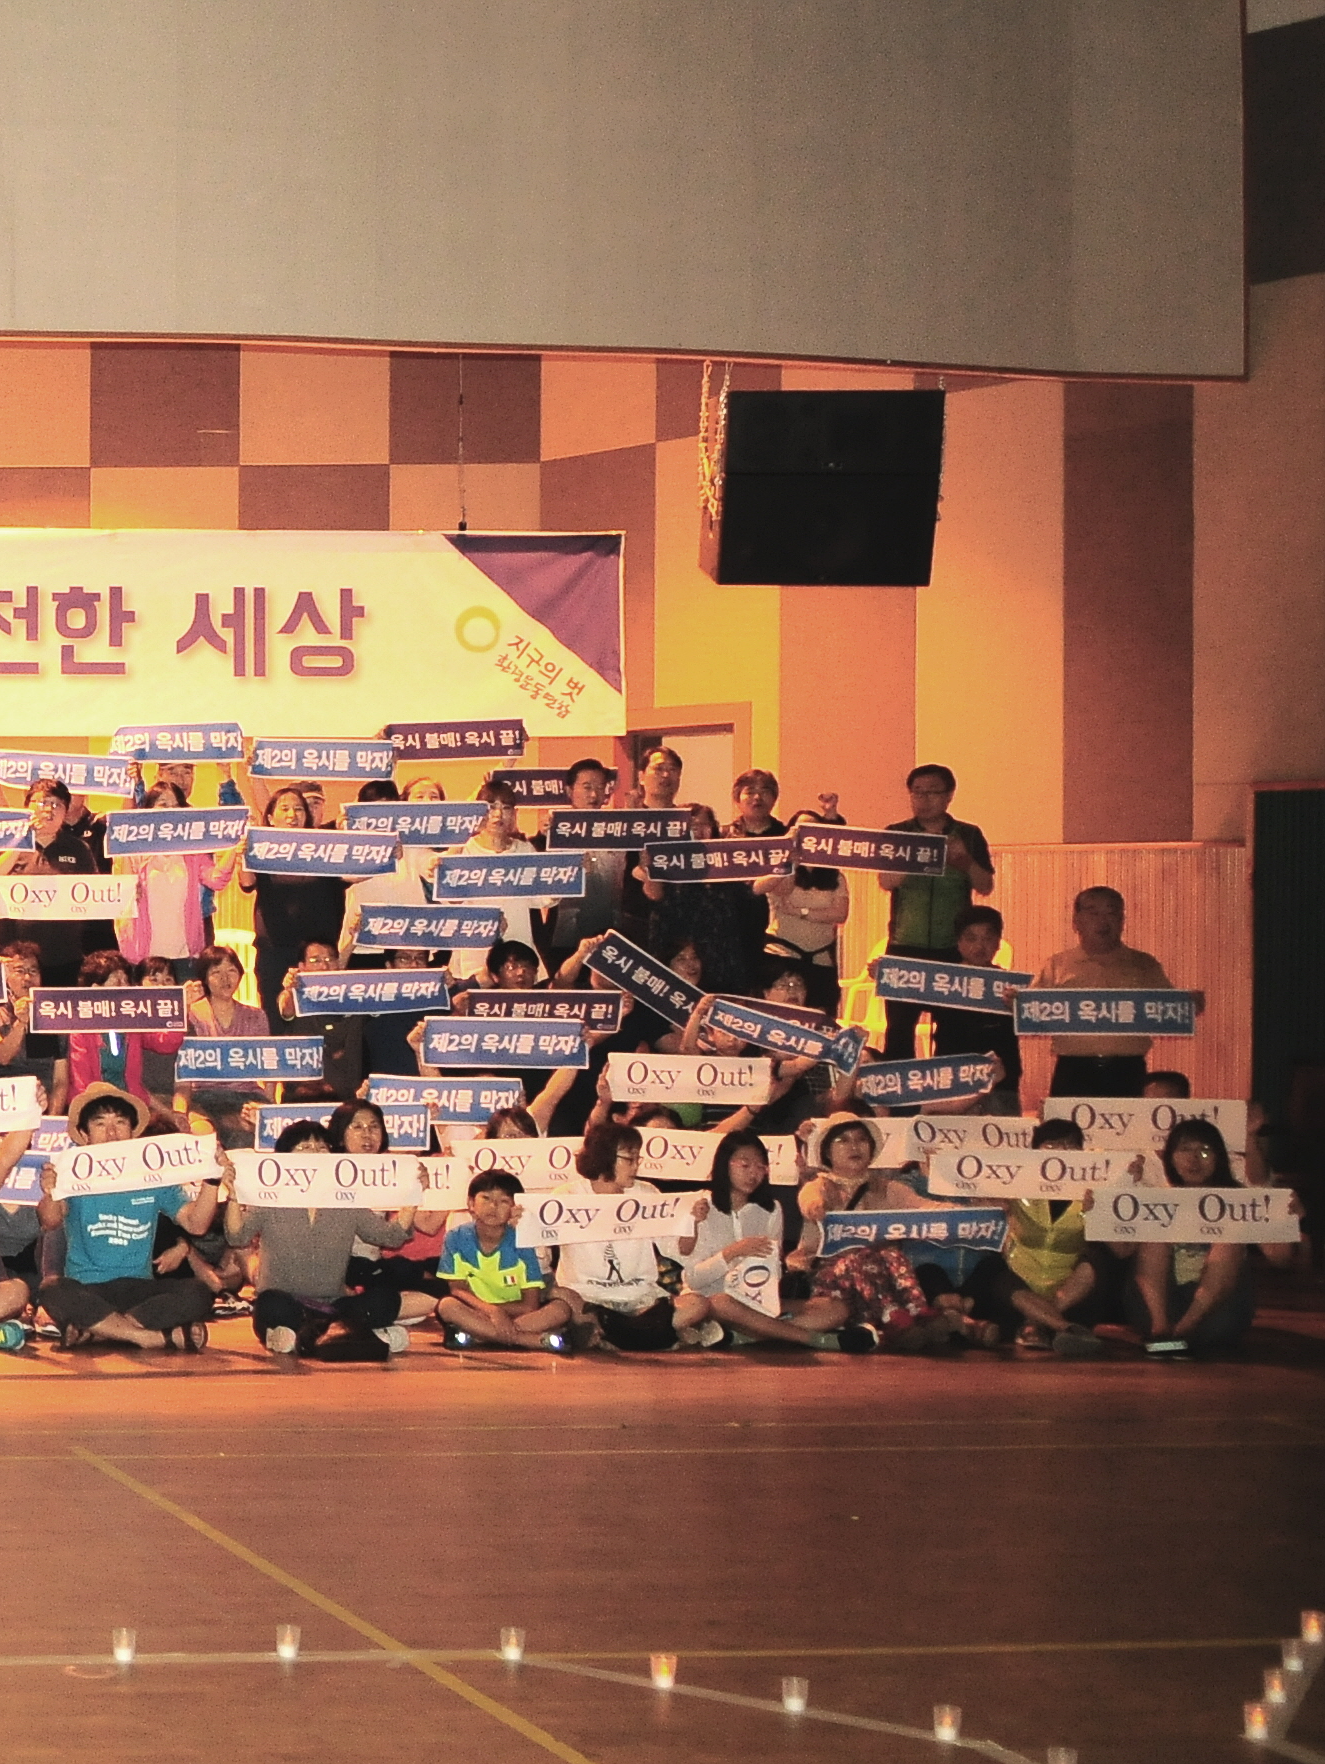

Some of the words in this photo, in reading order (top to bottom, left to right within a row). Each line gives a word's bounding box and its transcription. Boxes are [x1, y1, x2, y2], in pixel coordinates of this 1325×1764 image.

[177, 586, 365, 678] 세상
[507, 635, 563, 685] 지구의
[561, 677, 585, 703] 벗
[391, 732, 420, 749] 옥시
[425, 731, 461, 748] 불매!
[465, 729, 495, 746] 옥시
[499, 727, 520, 745] 끝!
[250, 843, 294, 861] 제2의
[298, 844, 347, 862] 옥시를
[352, 845, 391, 863] 막자!
[801, 836, 833, 855] 옥시
[838, 838, 875, 857] 불매!
[879, 843, 911, 860] 옥시
[916, 846, 938, 862] 끝!
[443, 867, 485, 887] 제2의
[488, 867, 536, 886] 옥시를
[539, 866, 576, 884] 막자!
[302, 987, 346, 1002] 제2의
[348, 984, 396, 1001] 옥시를
[403, 983, 439, 998] 막자!
[39, 1002, 72, 1019] 옥시
[78, 1001, 116, 1019] 불매!
[120, 1000, 152, 1016] 옥시
[156, 999, 179, 1016] 끝!
[1022, 1001, 1070, 1021] 제2의
[1077, 1000, 1136, 1021] 옥시를
[1144, 1000, 1190, 1021] 막자!
[180, 1049, 221, 1068] 제2의
[228, 1048, 278, 1070] 옥시를
[285, 1049, 323, 1070] 막자!
[258, 1159, 317, 1188] Oxy
[334, 1159, 397, 1187] Out!
[539, 1200, 600, 1229] Oxy
[616, 1198, 680, 1222] Out!
[1113, 1194, 1179, 1227] Oxy
[1199, 1193, 1270, 1222] Out!
